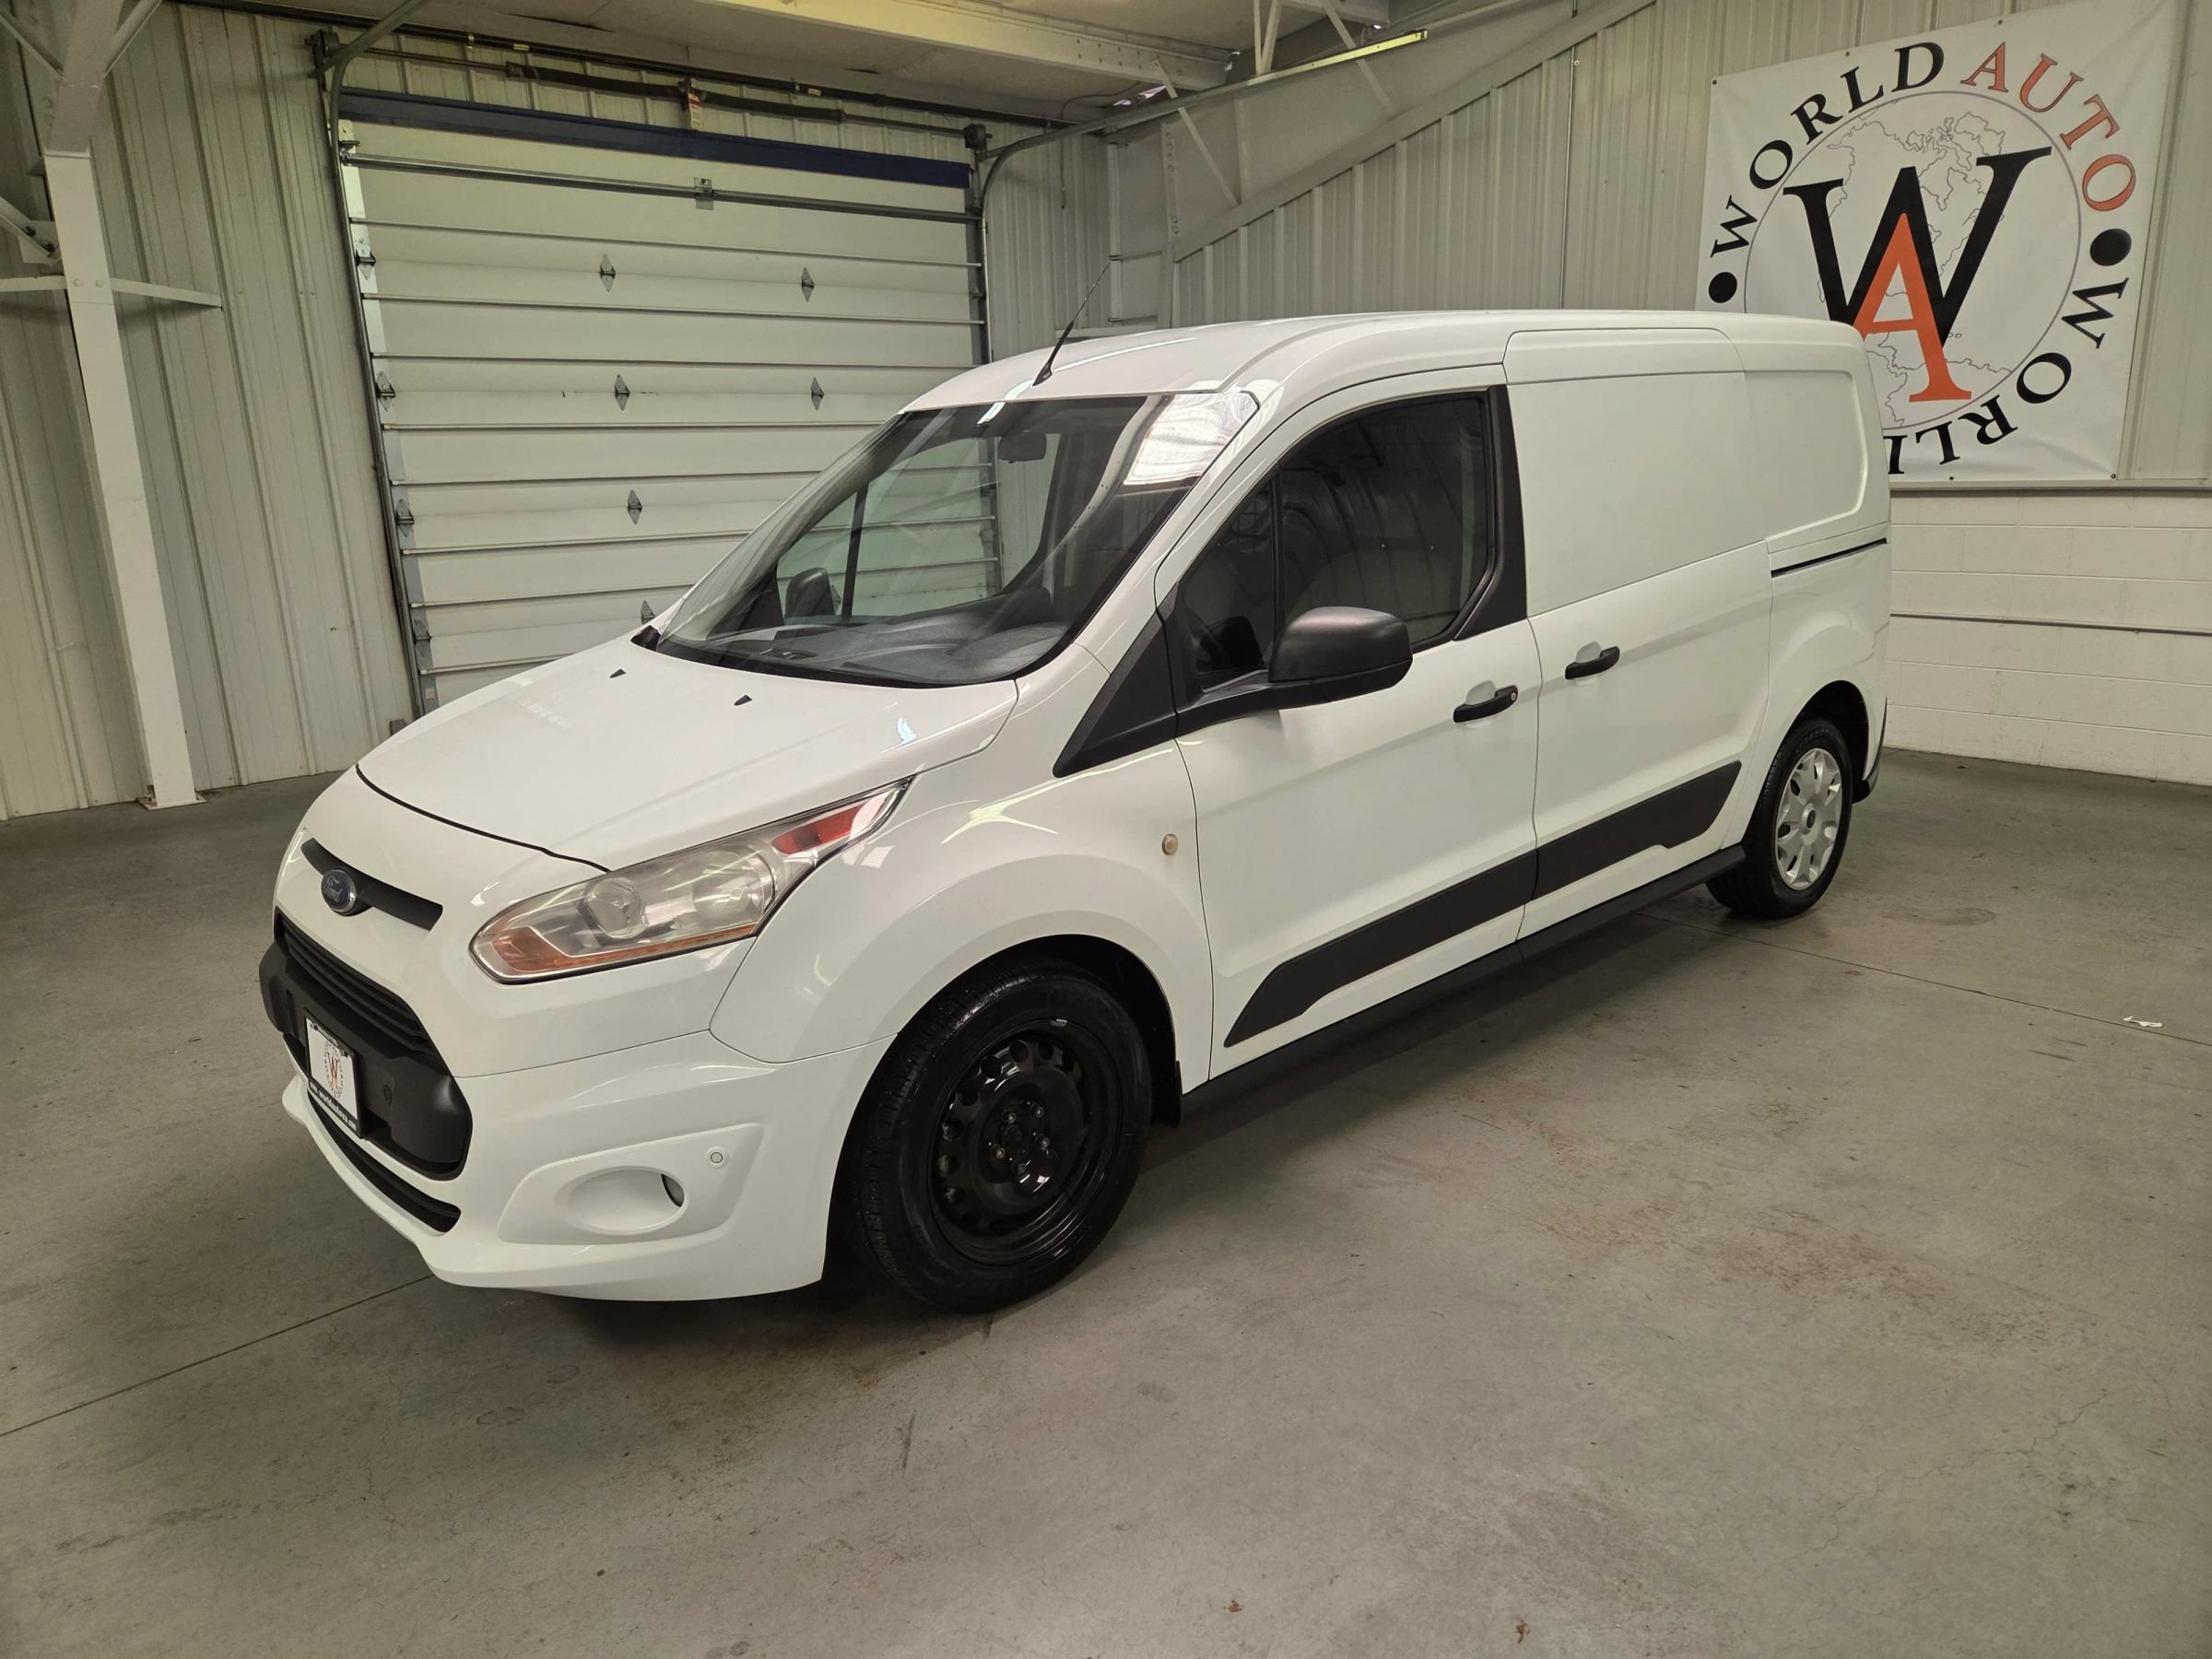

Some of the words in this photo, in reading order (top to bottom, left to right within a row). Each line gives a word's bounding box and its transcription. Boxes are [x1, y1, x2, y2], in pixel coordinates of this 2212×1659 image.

[1711, 41, 1945, 258] WORLD
[1959, 41, 2136, 212] AUTO
[324, 875, 343, 903] Ford
